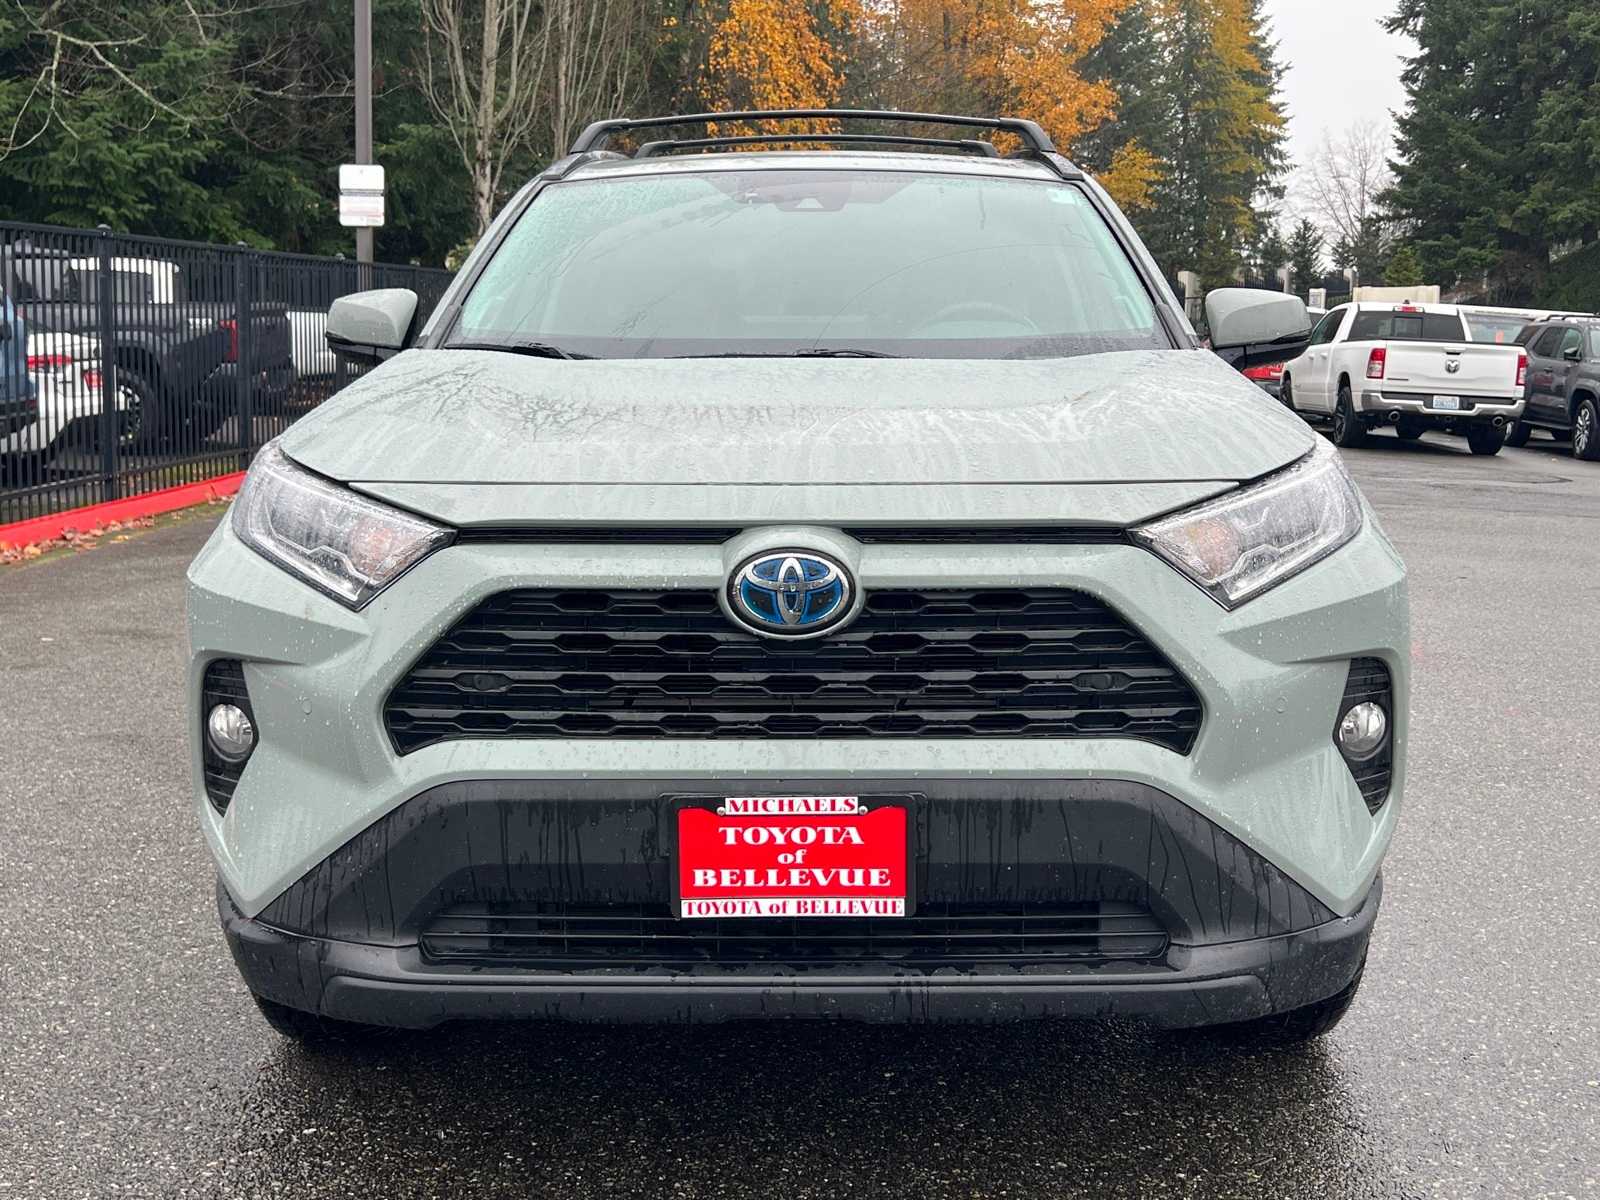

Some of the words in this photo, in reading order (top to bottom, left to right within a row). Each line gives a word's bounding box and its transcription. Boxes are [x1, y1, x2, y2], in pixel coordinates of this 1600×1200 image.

[728, 798, 856, 813] MICHAELS
[718, 826, 865, 845] TOYOTA
[777, 849, 807, 865] of
[692, 868, 891, 887] BELLEVUE
[683, 901, 761, 916] TOYOTA
[768, 900, 790, 915] of
[796, 900, 903, 915] BELLEVUE
